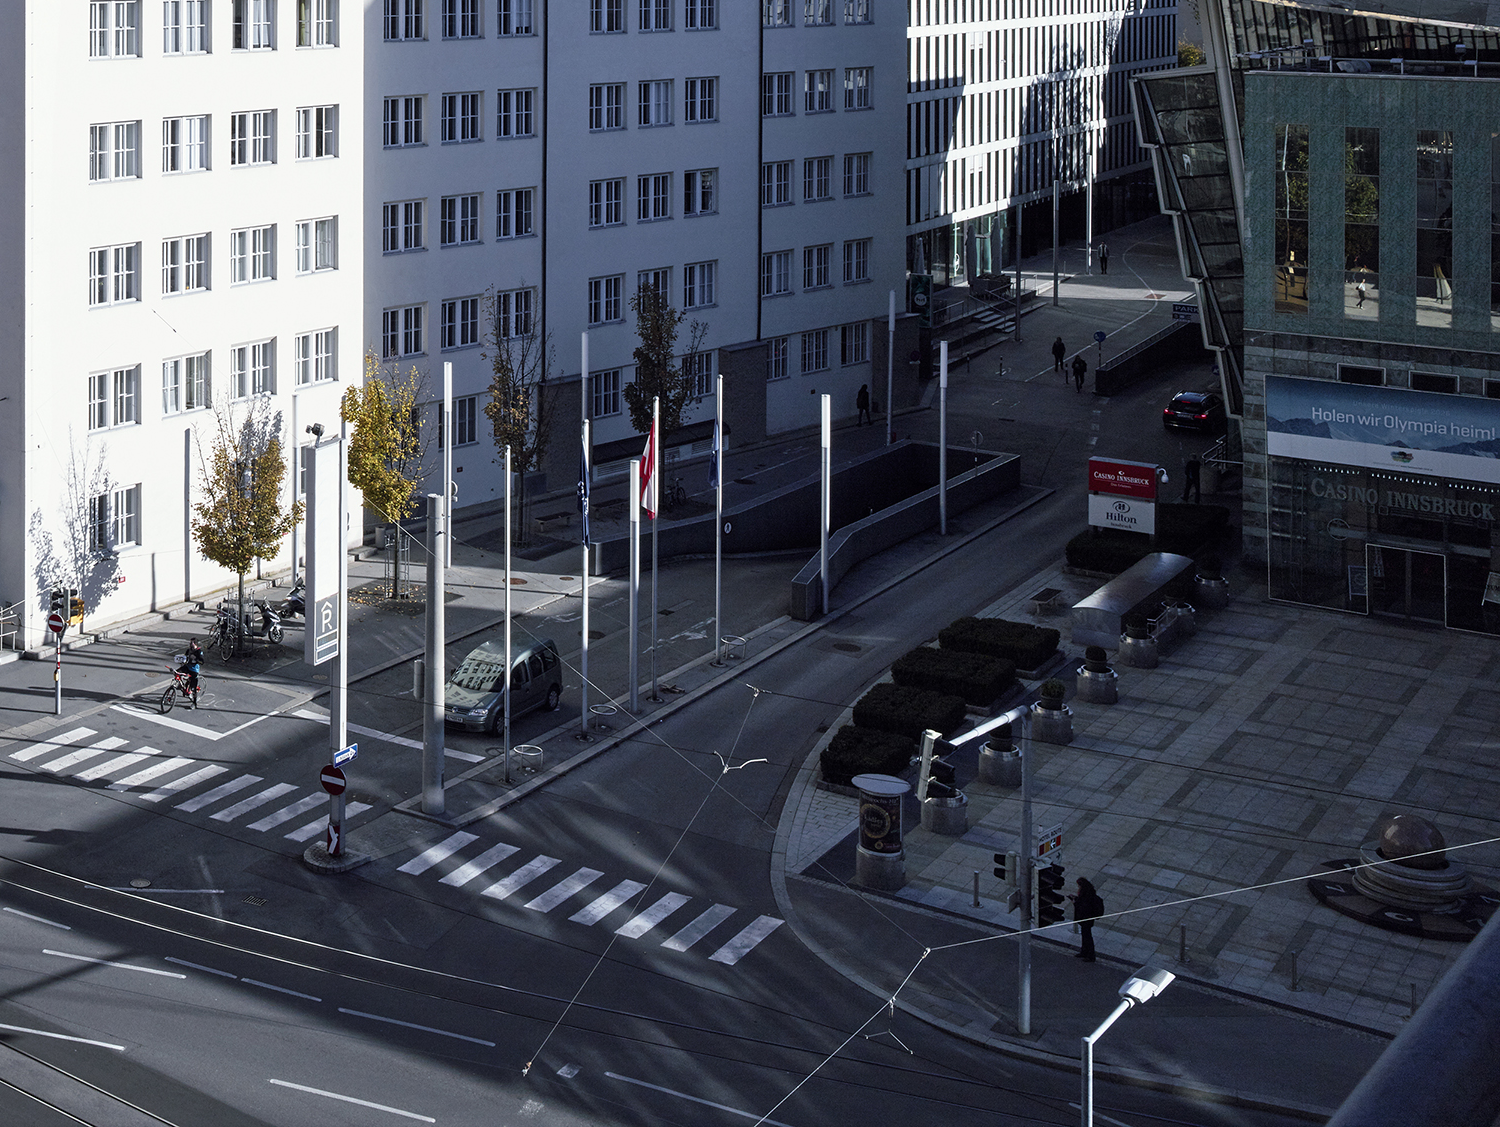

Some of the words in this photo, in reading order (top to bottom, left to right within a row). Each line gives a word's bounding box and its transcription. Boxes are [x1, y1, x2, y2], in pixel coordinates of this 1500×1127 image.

[1312, 407, 1355, 424] Holen
[1358, 414, 1381, 427] wir
[1384, 415, 1447, 435] Olympia
[1450, 422, 1496, 440] heim!
[1094, 471, 1115, 480] CASINO
[1117, 475, 1149, 486] INNSBRUCK
[1311, 477, 1378, 505] CASINO
[1386, 490, 1496, 521] INNSBRUCK
[1106, 512, 1137, 524] Hilton
